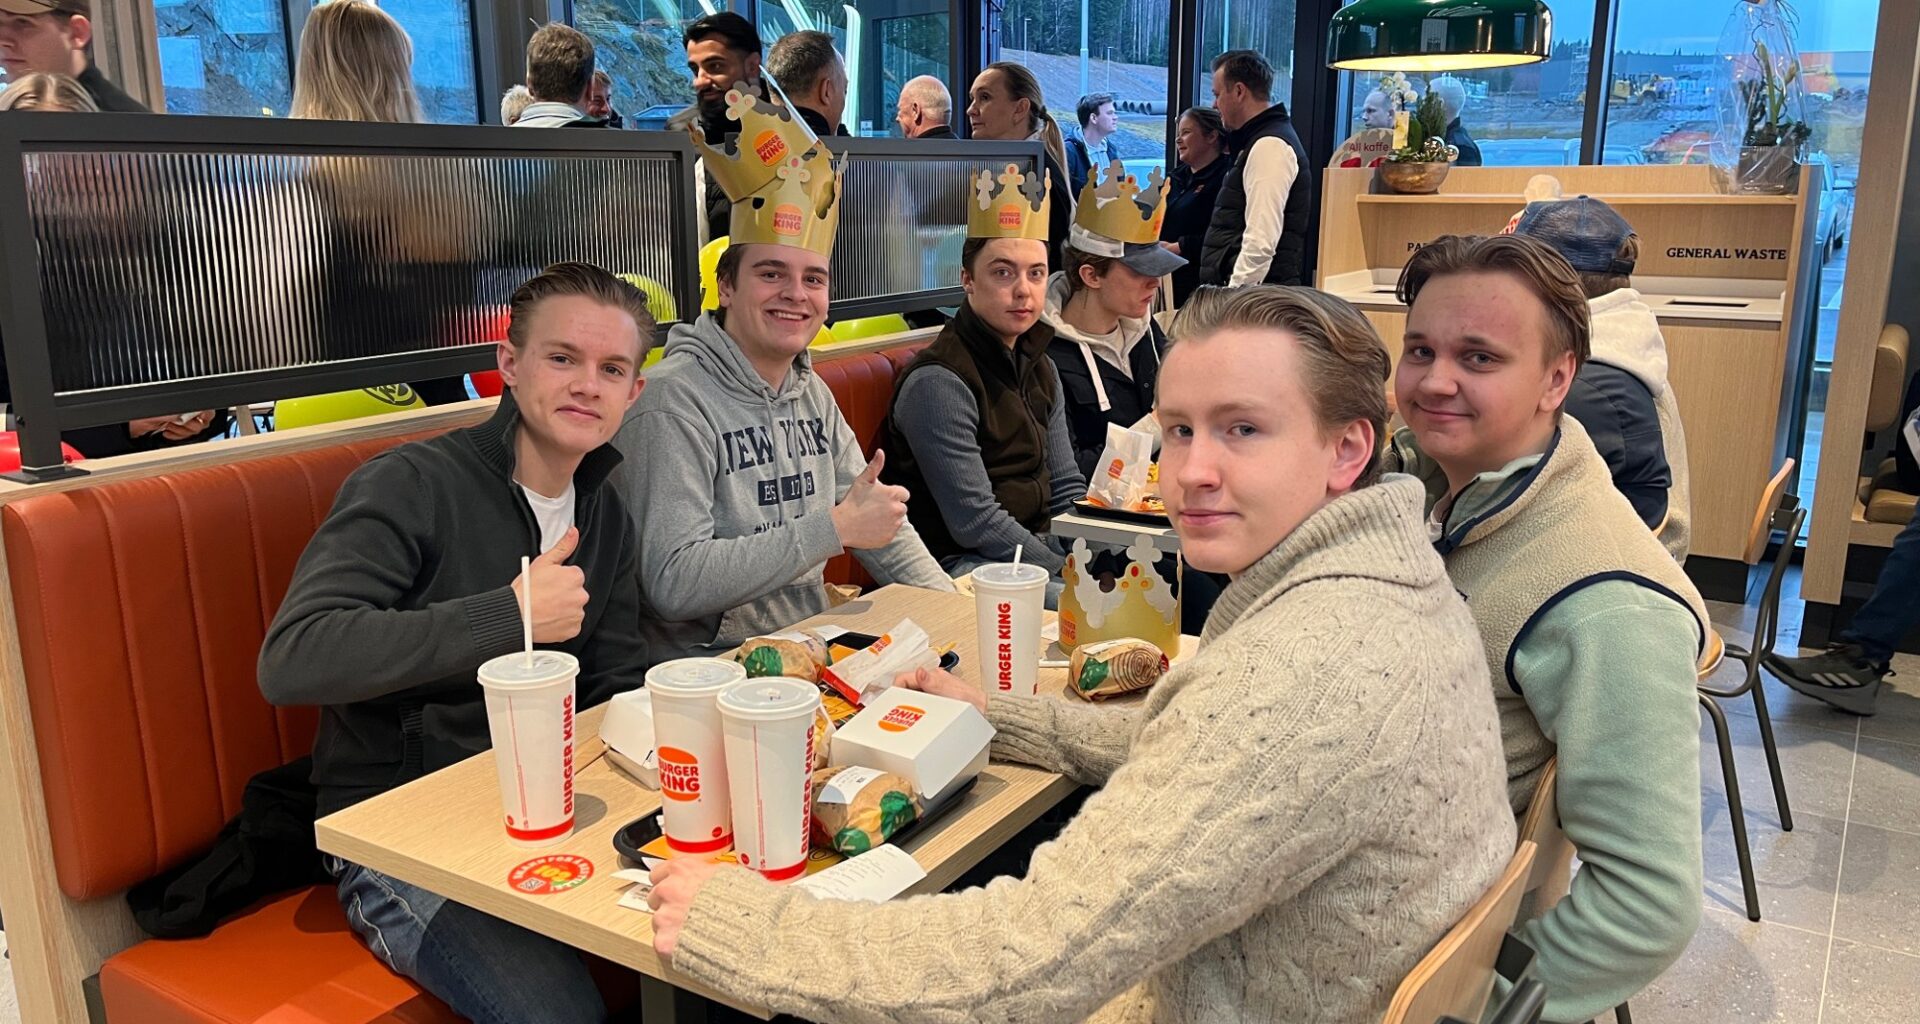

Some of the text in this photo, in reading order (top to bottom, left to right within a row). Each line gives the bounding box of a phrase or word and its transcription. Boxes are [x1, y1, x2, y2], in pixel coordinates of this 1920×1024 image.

[756, 134, 781, 156] BURGER
[760, 140, 785, 162] KING
[1363, 142, 1389, 152] kaffe
[774, 212, 802, 221] BURGER
[999, 216, 1021, 225] KING
[773, 219, 801, 231] KING
[1666, 247, 1787, 260] GENERAL WASTE
[779, 418, 830, 459] YRK
[998, 602, 1012, 691] URGER KING
[882, 714, 915, 728] BURGER
[888, 708, 923, 722] KING
[563, 694, 574, 816] BURGER KING
[658, 758, 700, 777] BURGER
[660, 772, 701, 793] KING
